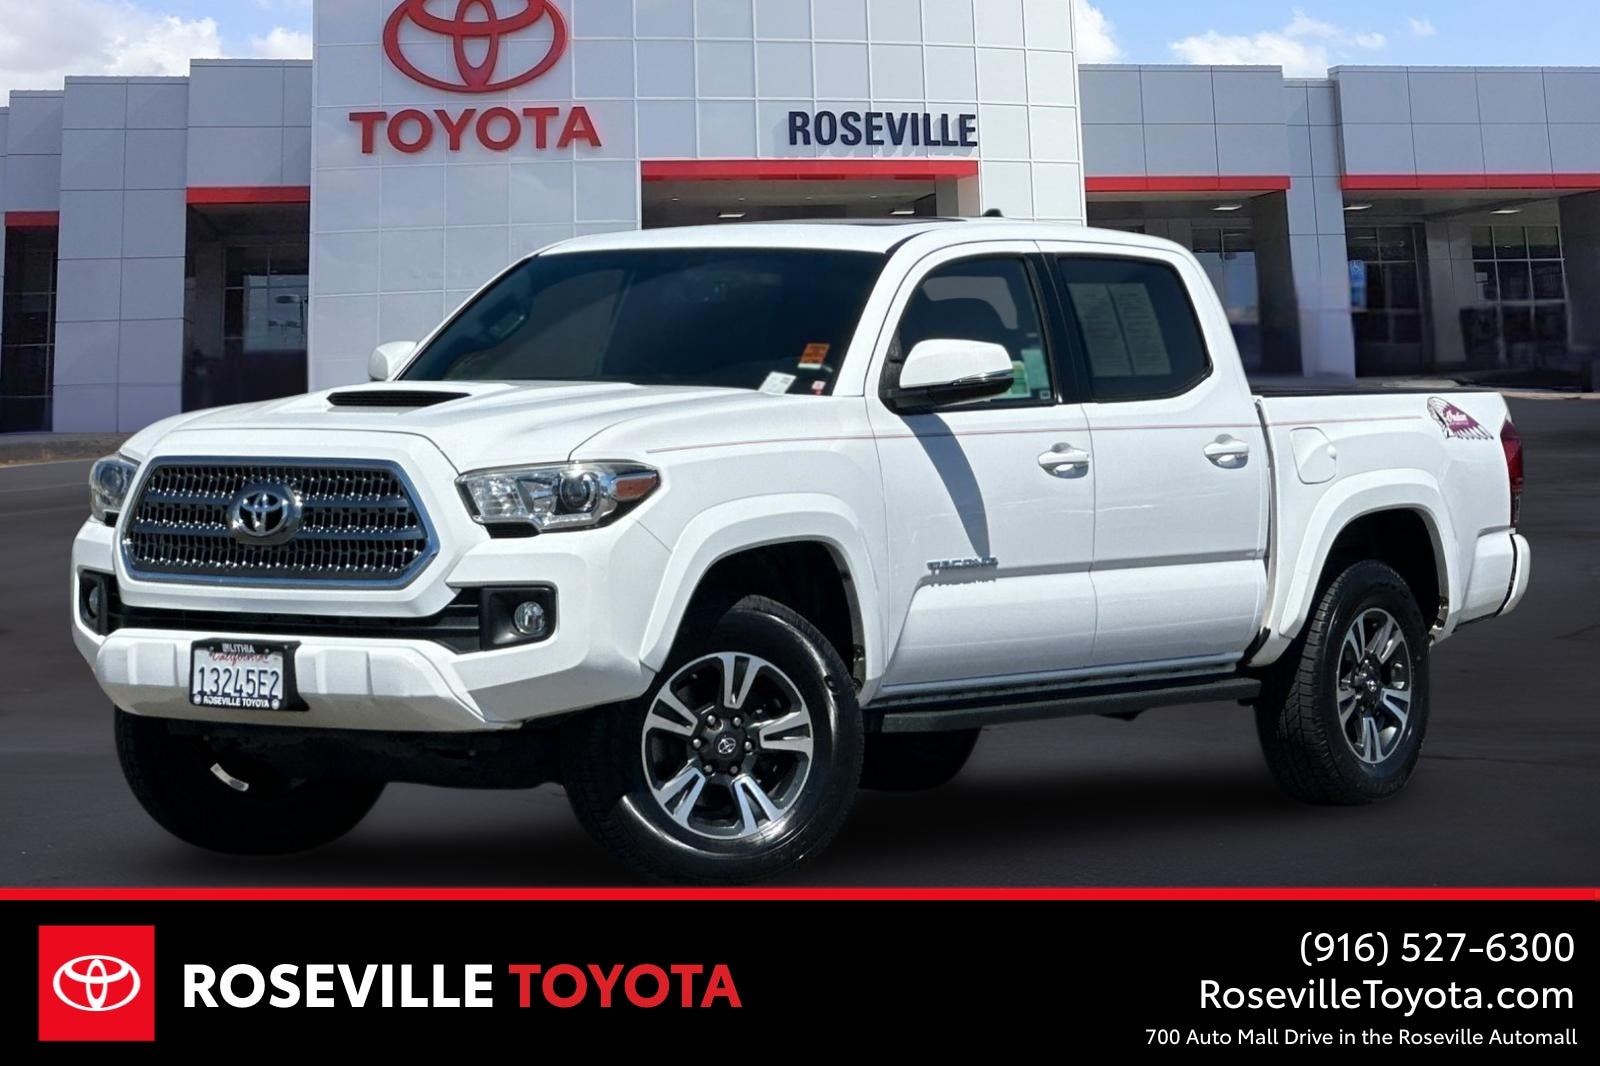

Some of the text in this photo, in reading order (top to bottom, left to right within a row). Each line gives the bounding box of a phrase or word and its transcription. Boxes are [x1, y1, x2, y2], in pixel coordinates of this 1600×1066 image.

[349, 106, 602, 154] TOYOTA
[788, 110, 978, 147] ROSEVILLE
[230, 643, 255, 653] LITHIA
[197, 666, 280, 699] 13245E2
[203, 696, 270, 708] ROSEVILLE TOYOTA
